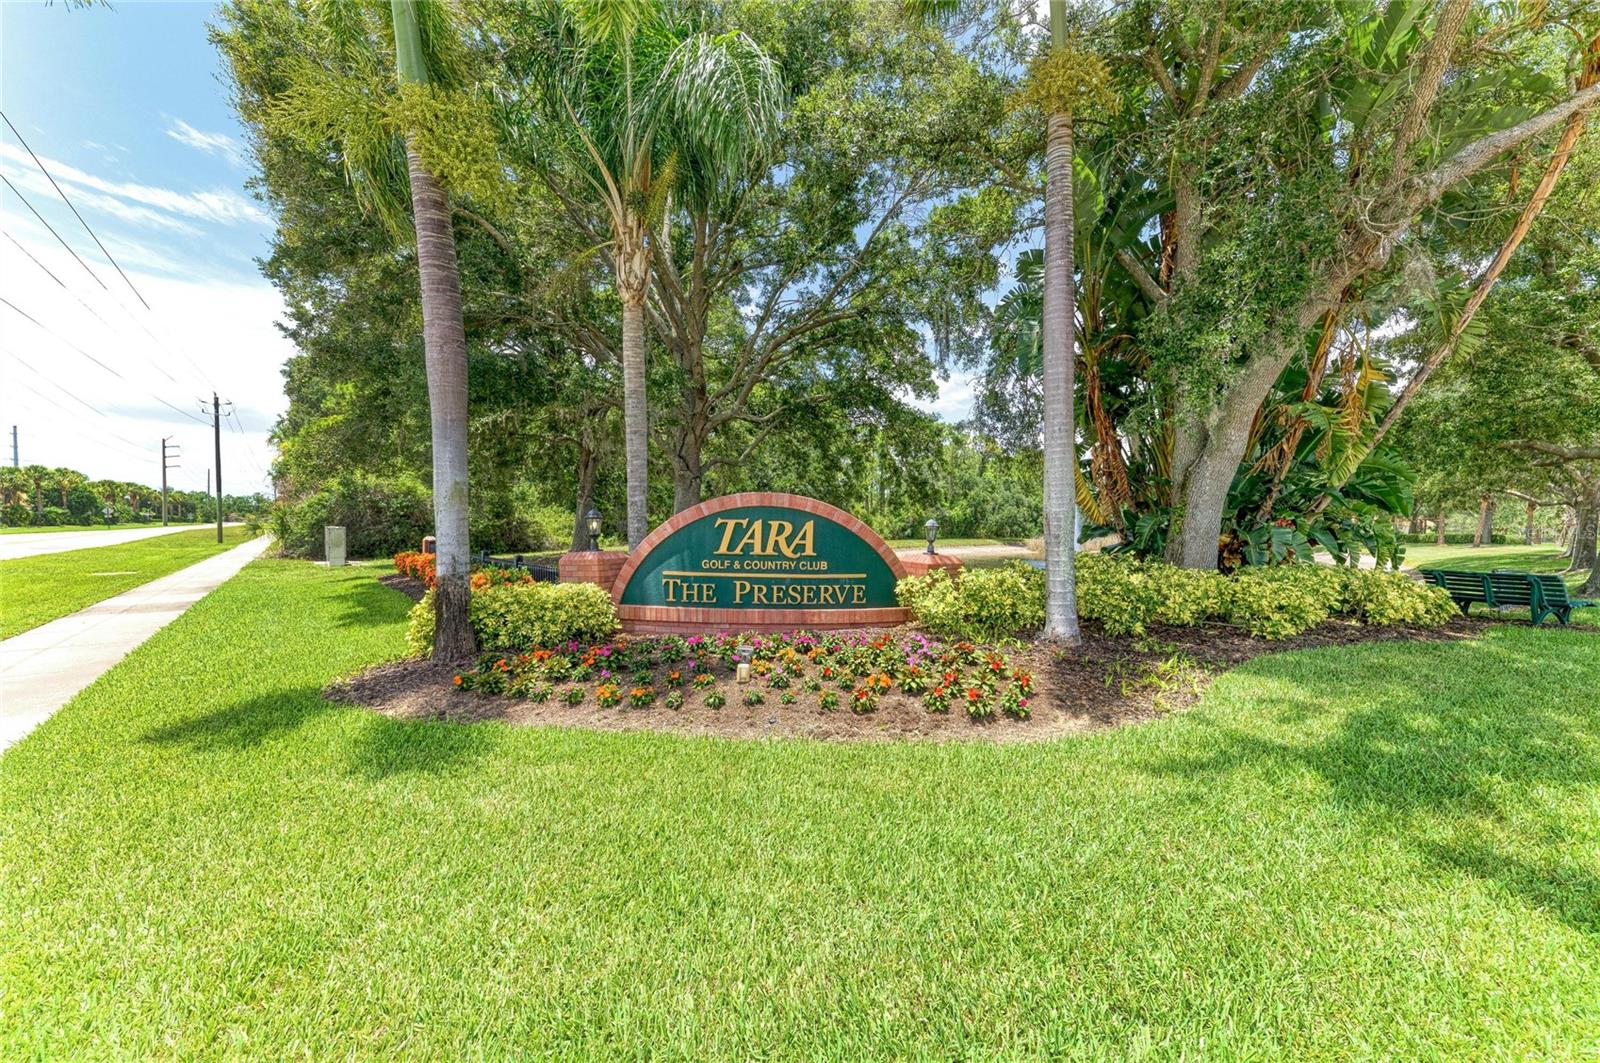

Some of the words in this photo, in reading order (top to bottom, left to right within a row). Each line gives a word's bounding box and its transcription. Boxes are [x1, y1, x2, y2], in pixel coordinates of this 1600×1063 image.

[713, 517, 817, 559] TARA
[701, 559, 731, 569] GOLF
[733, 560, 741, 570] &
[744, 560, 797, 570] COUNTRY
[799, 561, 828, 570] CLUB
[662, 578, 717, 603] THE
[732, 580, 867, 605] PRESERVE
